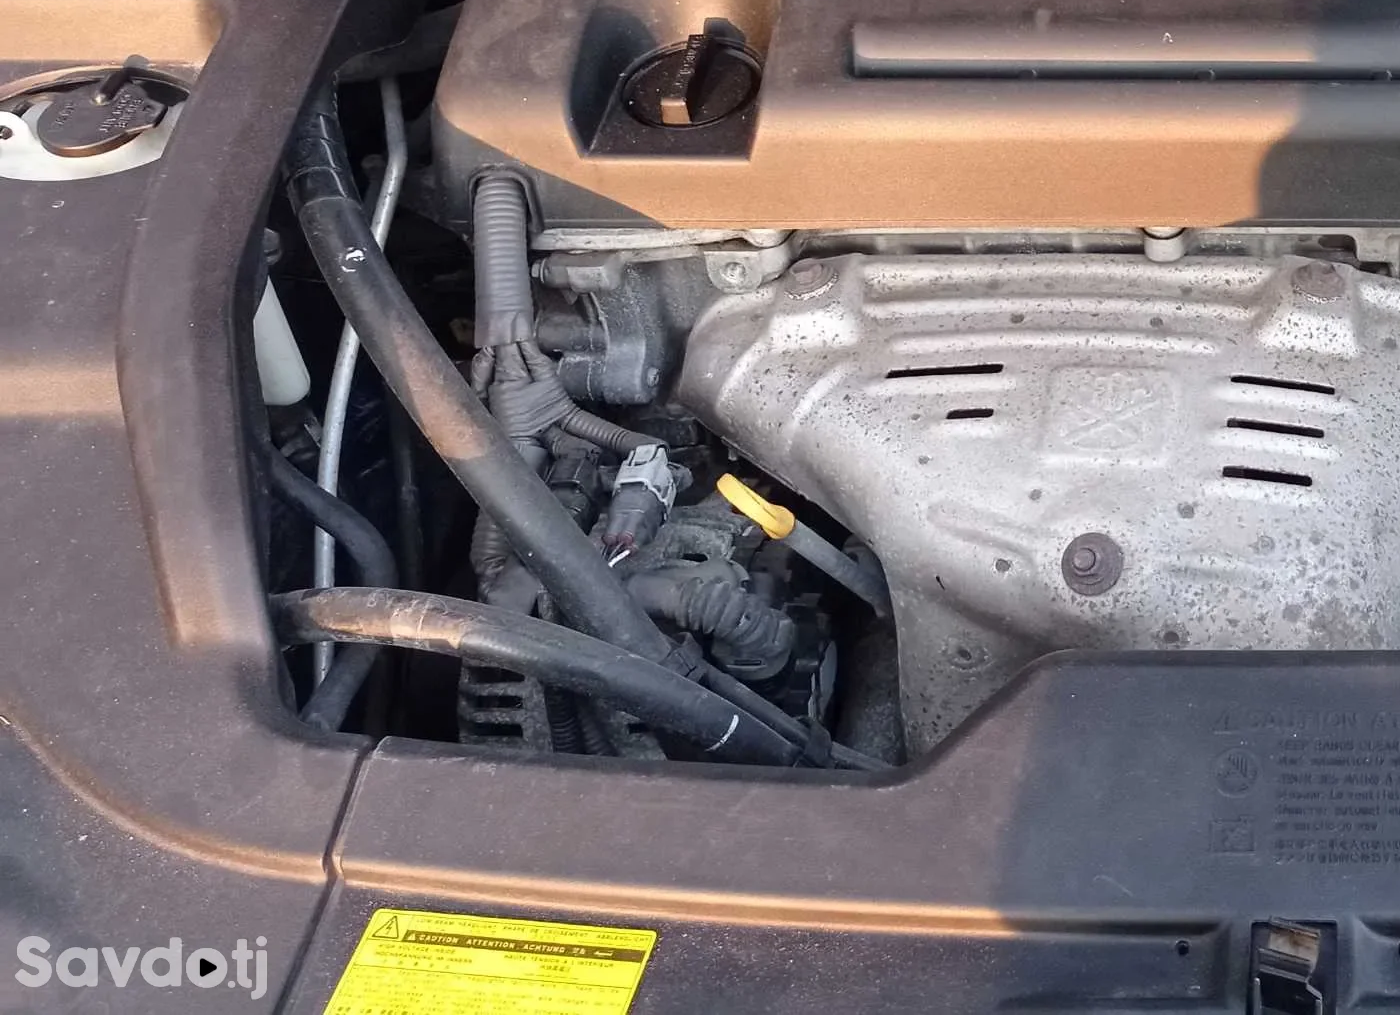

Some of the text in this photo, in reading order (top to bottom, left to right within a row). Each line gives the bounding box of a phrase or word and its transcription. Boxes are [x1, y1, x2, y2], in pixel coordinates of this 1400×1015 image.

[418, 934, 459, 945] CAUTION
[466, 938, 517, 950] ATTENTION
[523, 943, 566, 954] ACHTUNG
